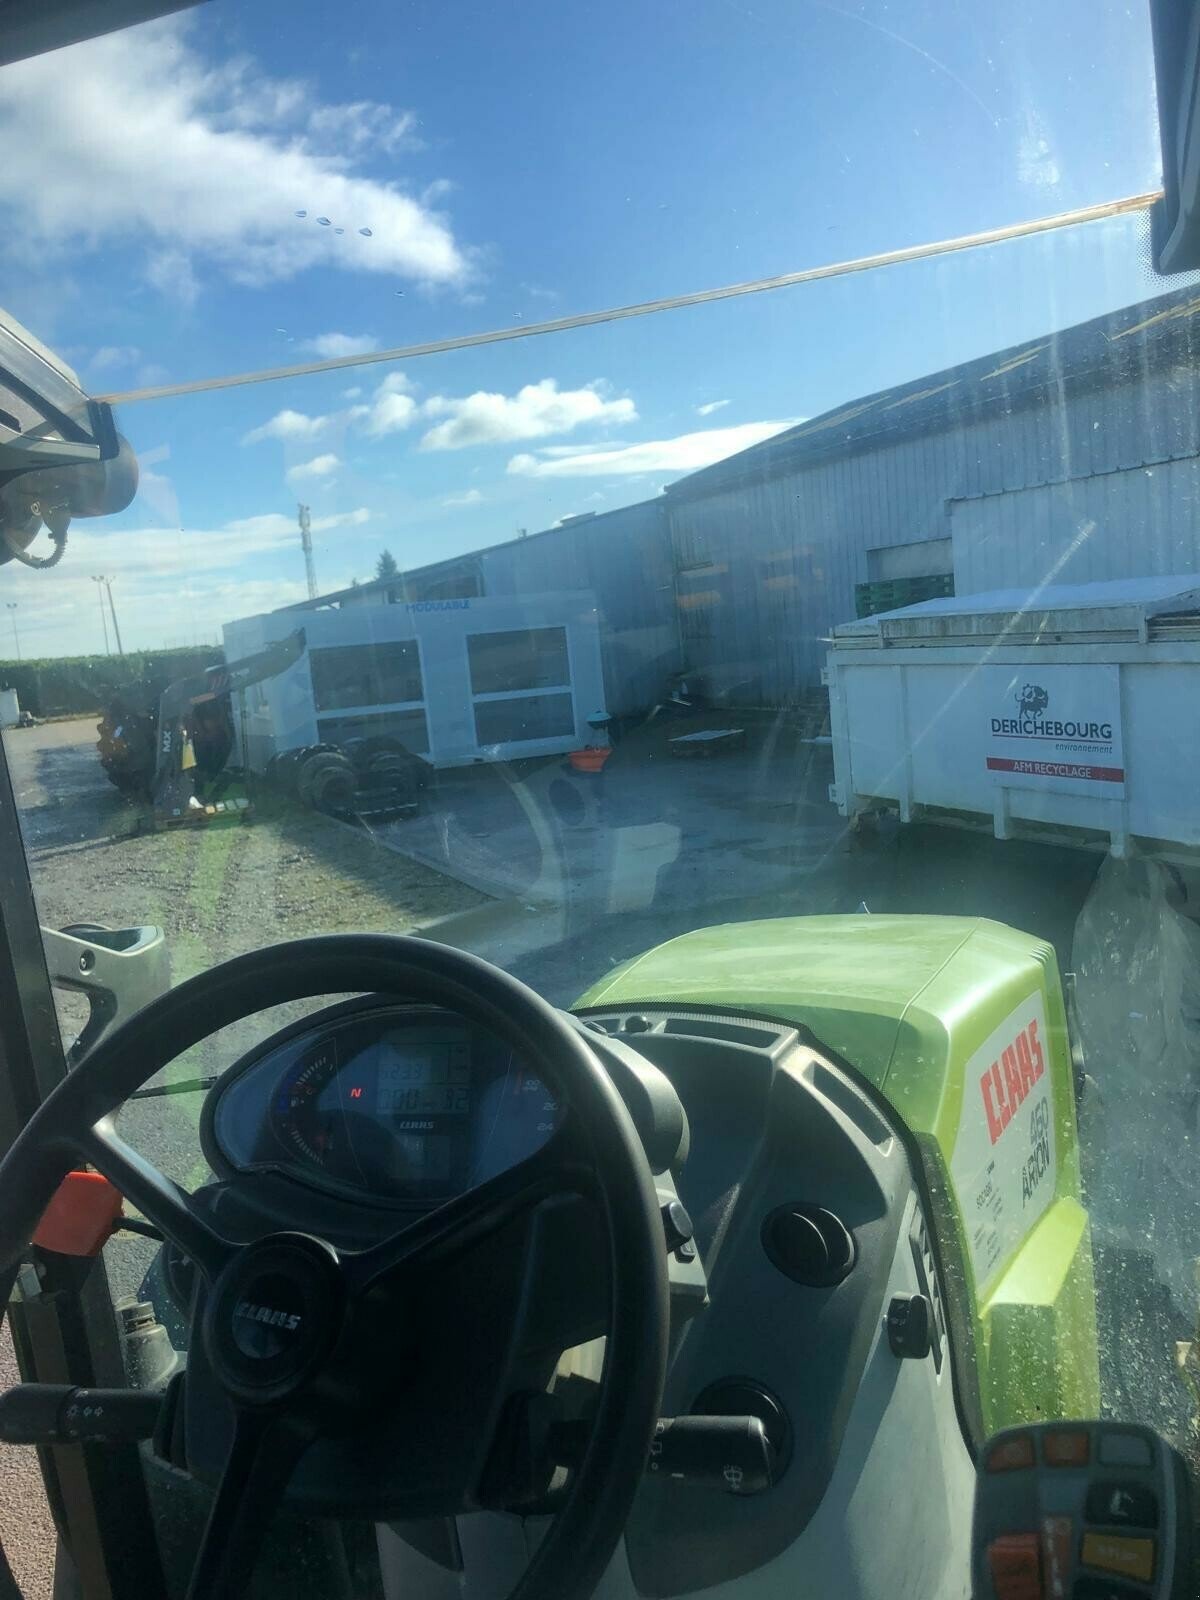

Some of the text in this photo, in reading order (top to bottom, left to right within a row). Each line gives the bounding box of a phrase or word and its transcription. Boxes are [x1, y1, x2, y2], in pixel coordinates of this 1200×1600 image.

[991, 719, 1112, 739] DERICHEBOURG
[161, 731, 172, 753] MX
[1055, 743, 1112, 754] environnement
[1013, 761, 1091, 778] AFM RECYCLAGE
[979, 1017, 1045, 1146] CLAAS
[350, 1087, 363, 1098] N
[236, 1301, 301, 1330] CLAAS
